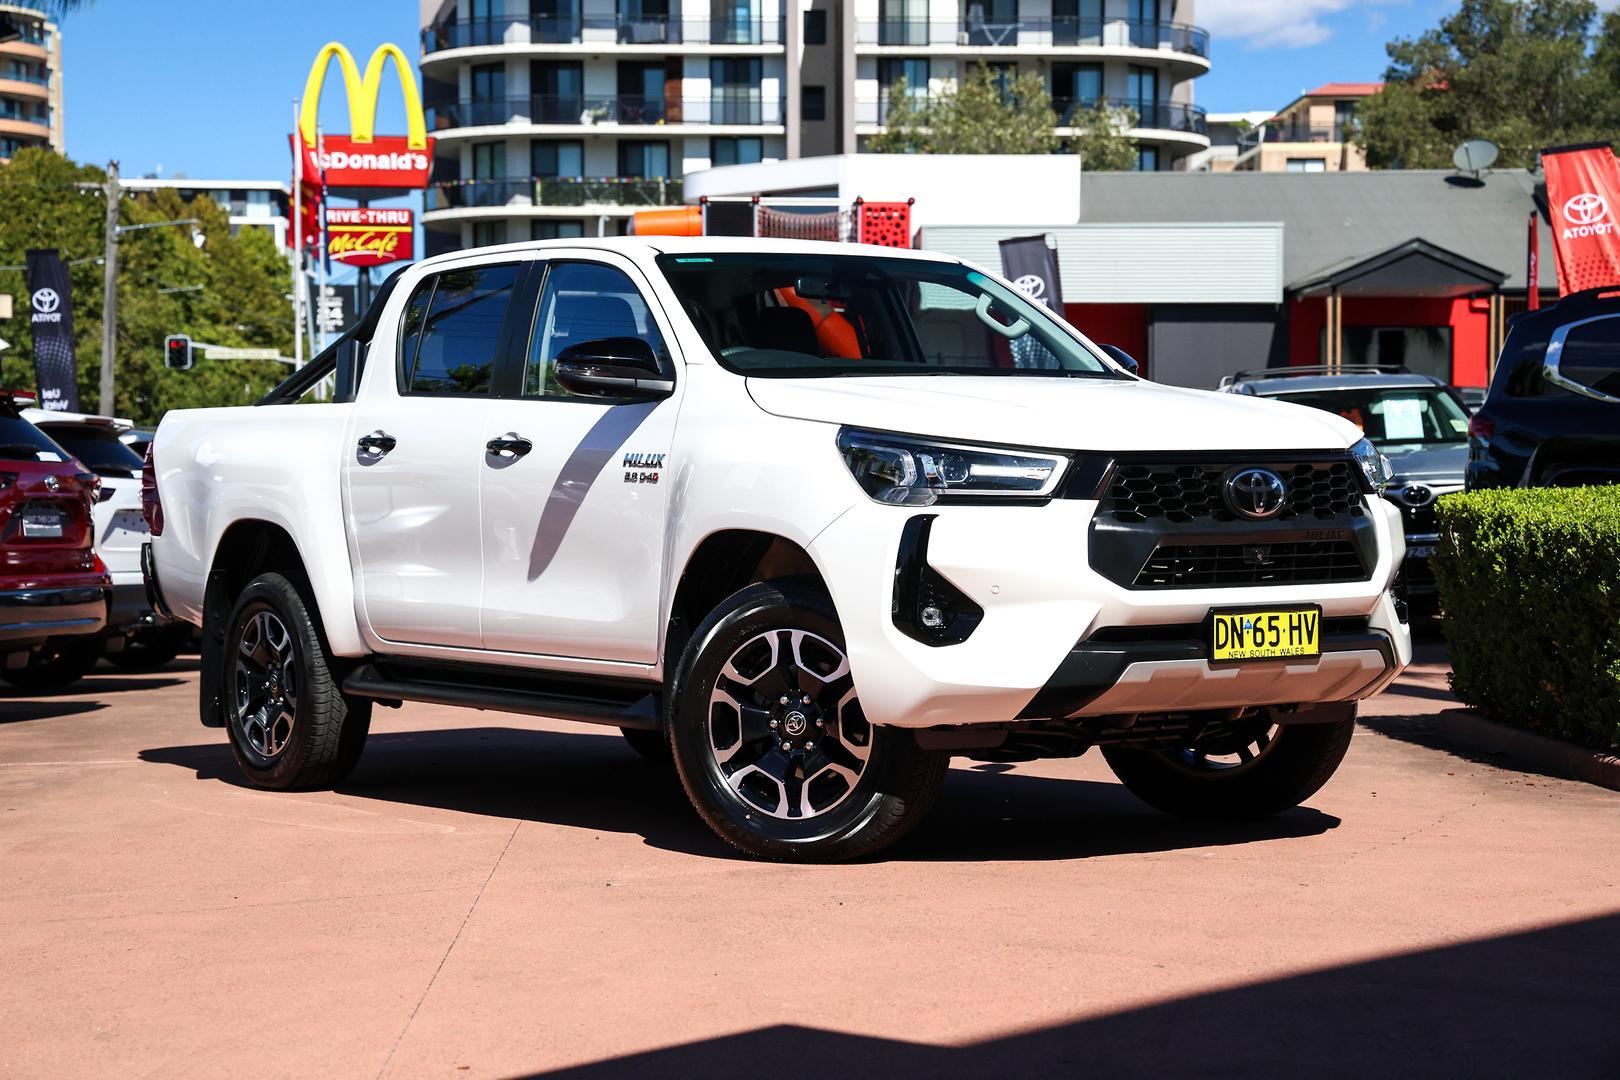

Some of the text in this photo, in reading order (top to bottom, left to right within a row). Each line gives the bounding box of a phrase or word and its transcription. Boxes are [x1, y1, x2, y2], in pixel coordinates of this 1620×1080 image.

[326, 209, 409, 224] RIVE-THRU
[623, 453, 666, 468] HILUX
[1228, 647, 1305, 659] NEW SOUTH WALES
